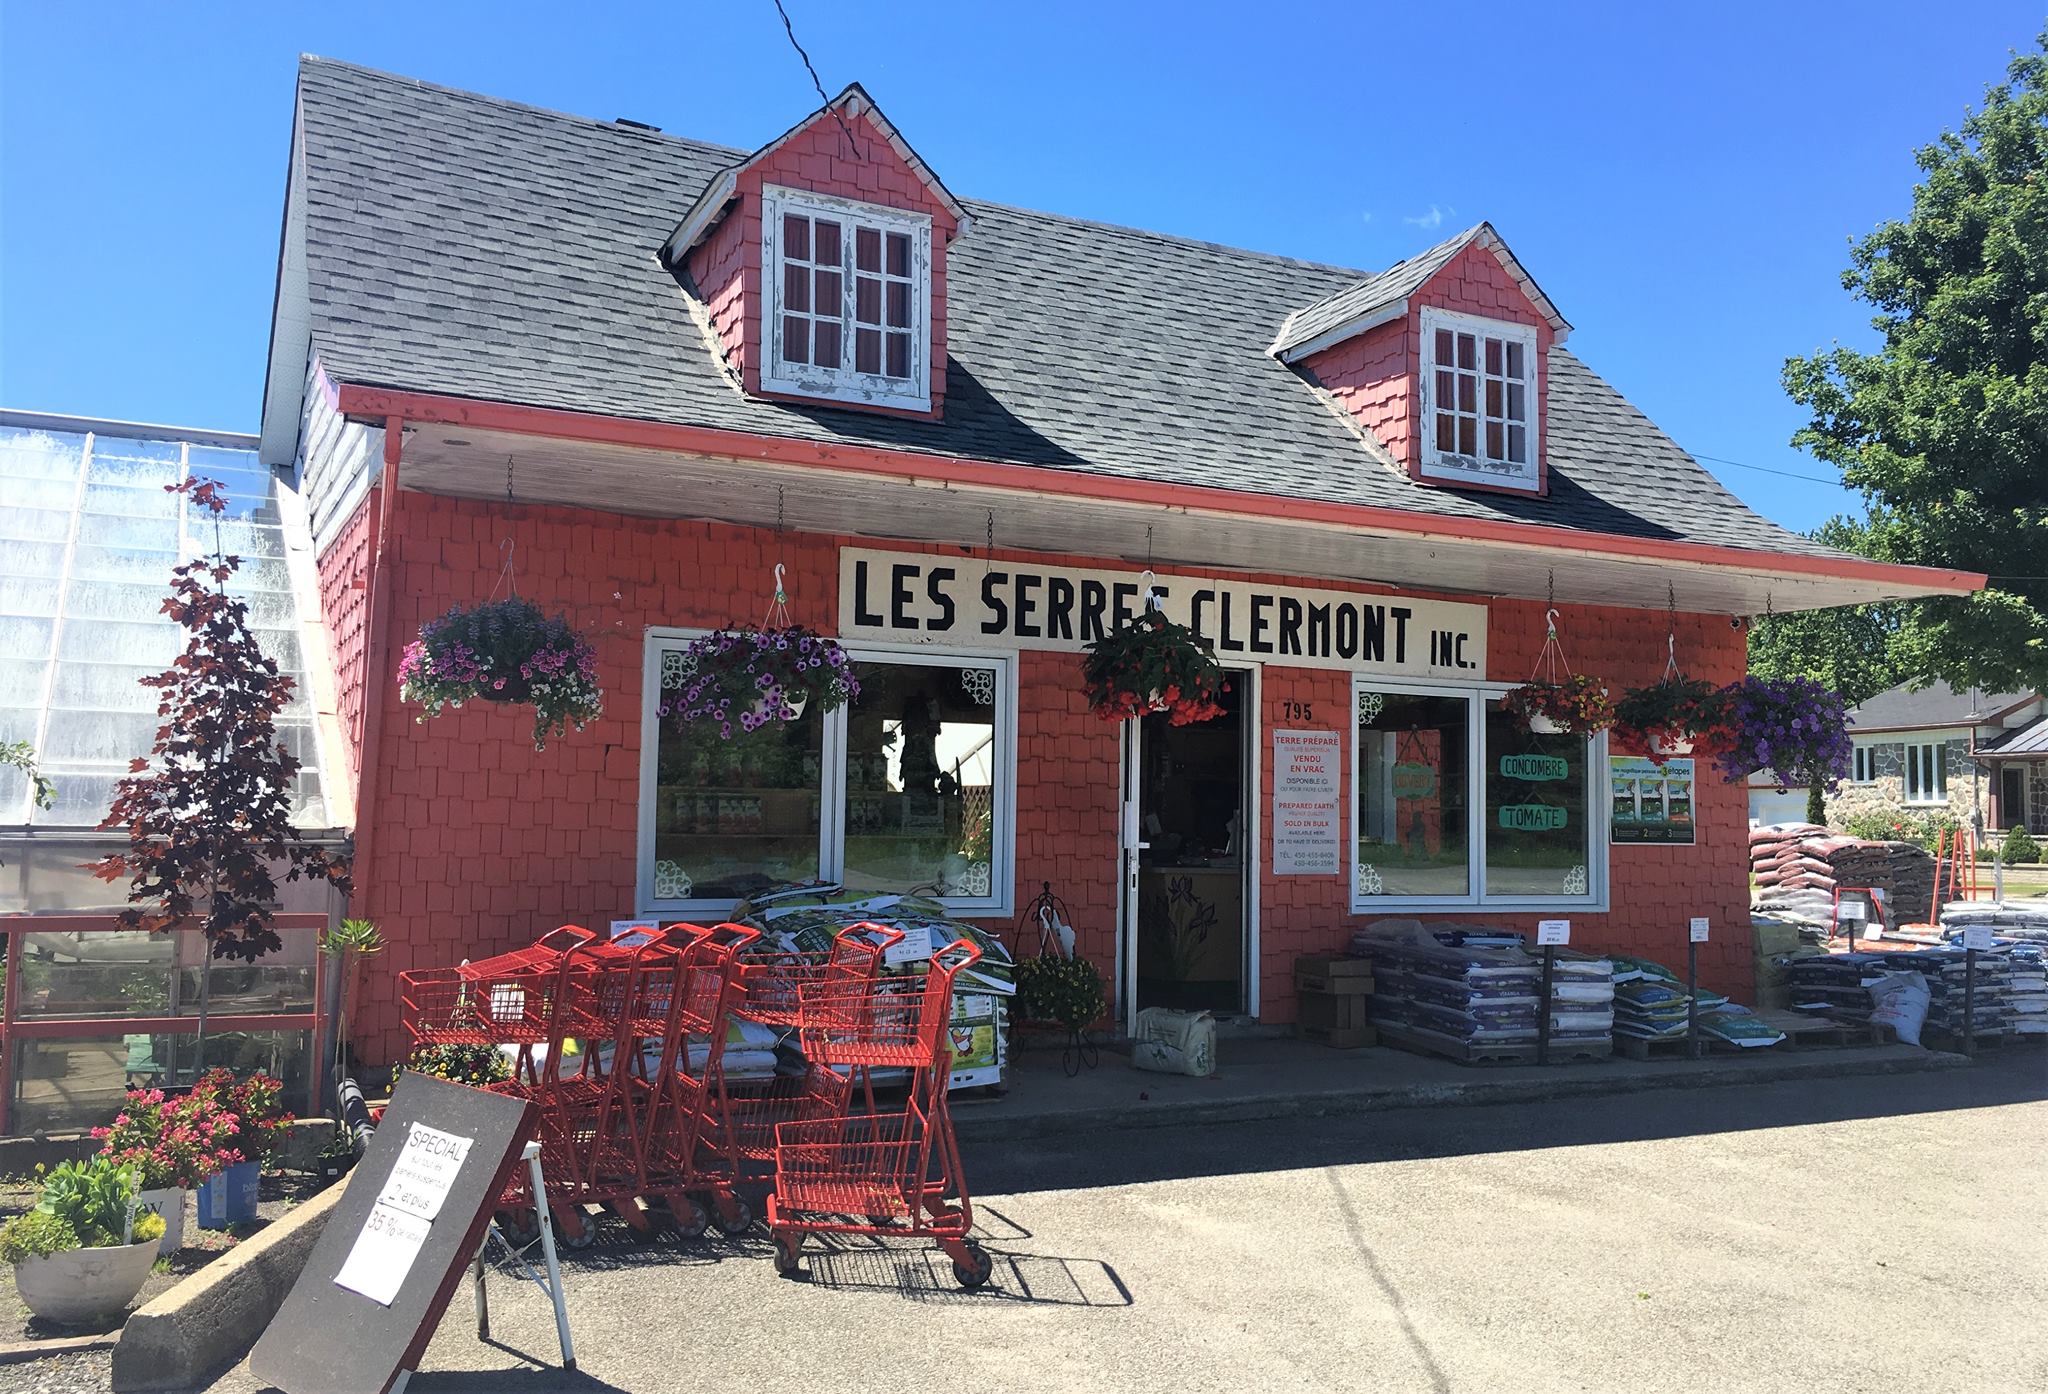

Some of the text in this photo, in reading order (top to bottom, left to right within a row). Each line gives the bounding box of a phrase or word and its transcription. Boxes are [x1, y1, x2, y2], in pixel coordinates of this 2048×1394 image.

[855, 560, 1476, 669] LES SERRE CLERMONT INC.
[1283, 702, 1312, 720] 795
[1275, 736, 1301, 744] TERRE
[1294, 755, 1321, 763] VENDU
[1505, 758, 1563, 777] CONCOMBRE
[1662, 766, 1668, 777] 3
[1667, 766, 1690, 777] étapes
[1505, 808, 1560, 826] TOMATE
[410, 1130, 462, 1161] SPECIAL
[401, 1193, 412, 1204] et
[410, 1195, 430, 1210] plus
[368, 1210, 386, 1231] 35
[386, 1217, 399, 1238] %
